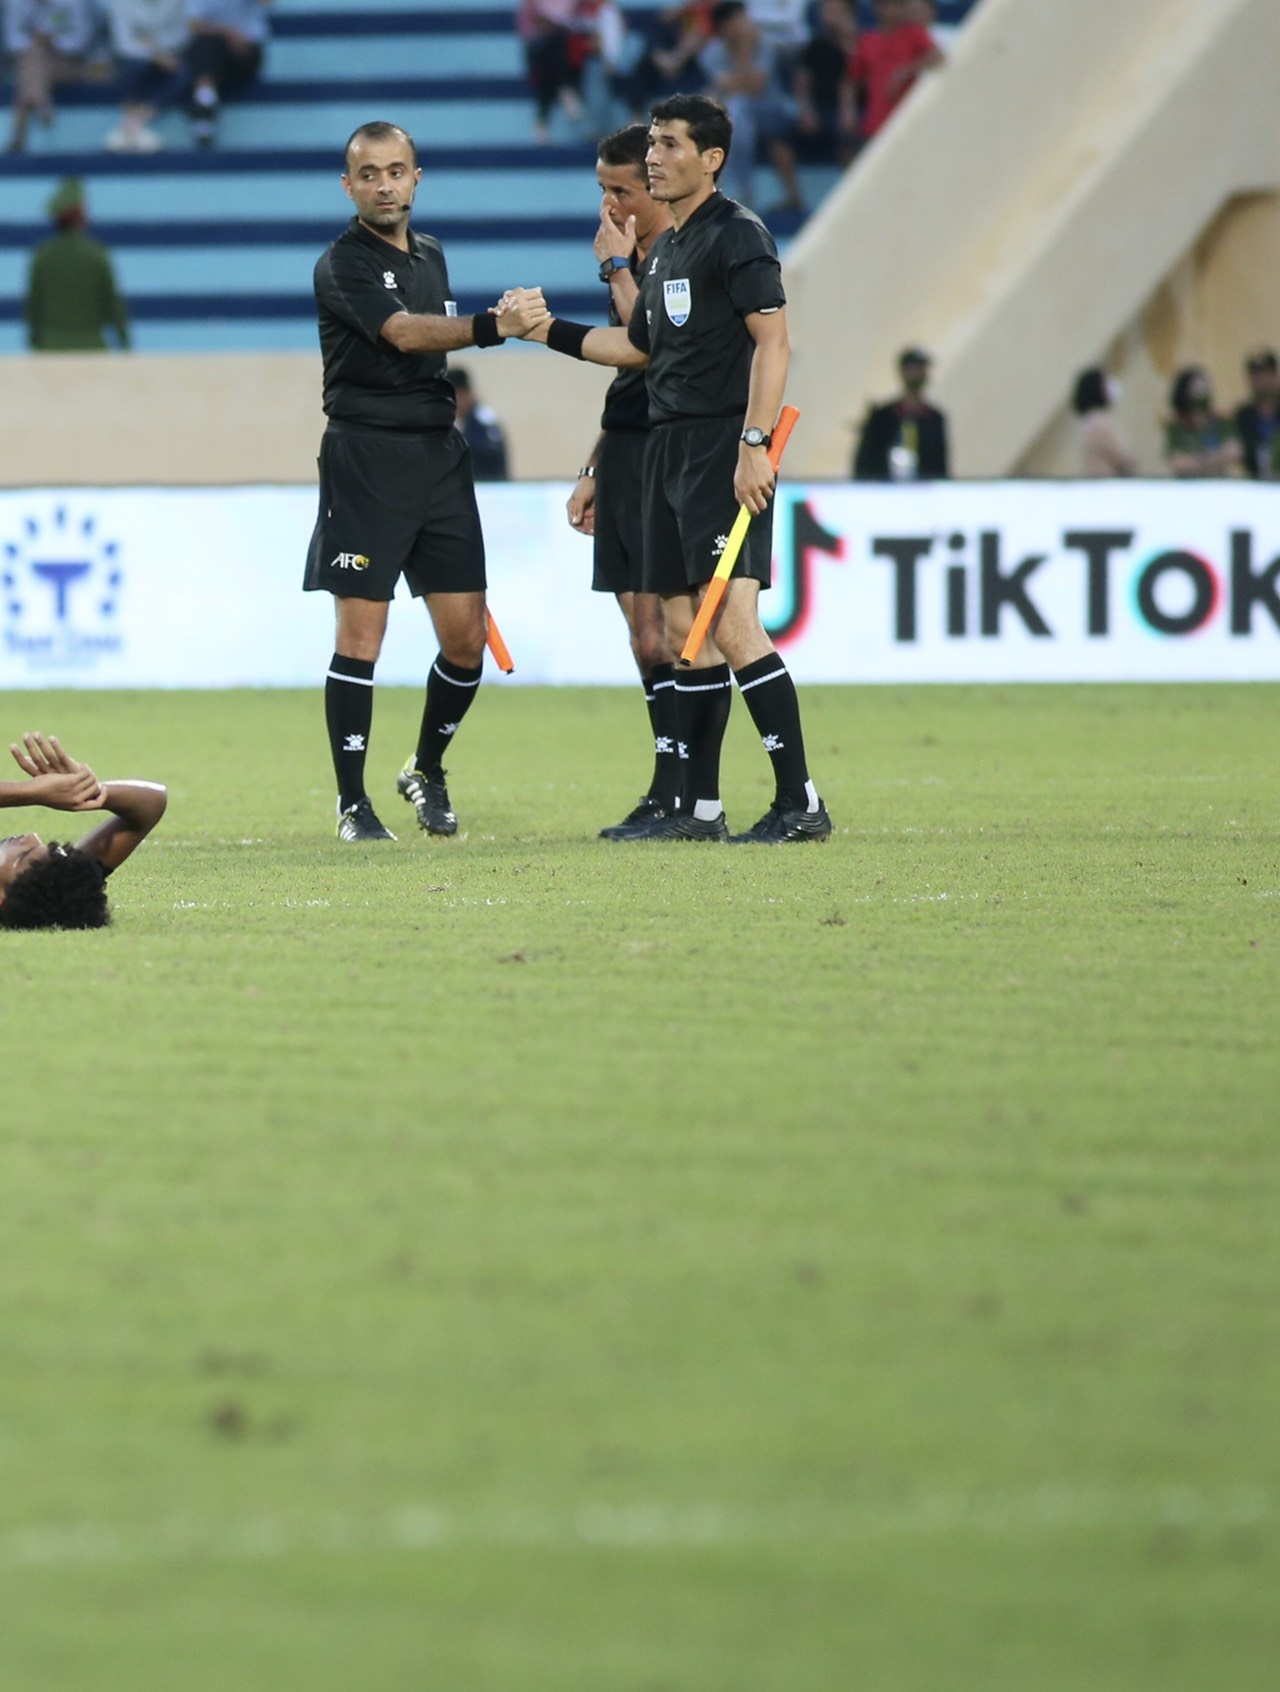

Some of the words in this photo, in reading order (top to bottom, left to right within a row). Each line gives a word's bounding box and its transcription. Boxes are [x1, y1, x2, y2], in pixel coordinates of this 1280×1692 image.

[666, 282, 687, 294] FIFA
[330, 552, 368, 570] AFC
[871, 529, 1280, 642] TikTok
